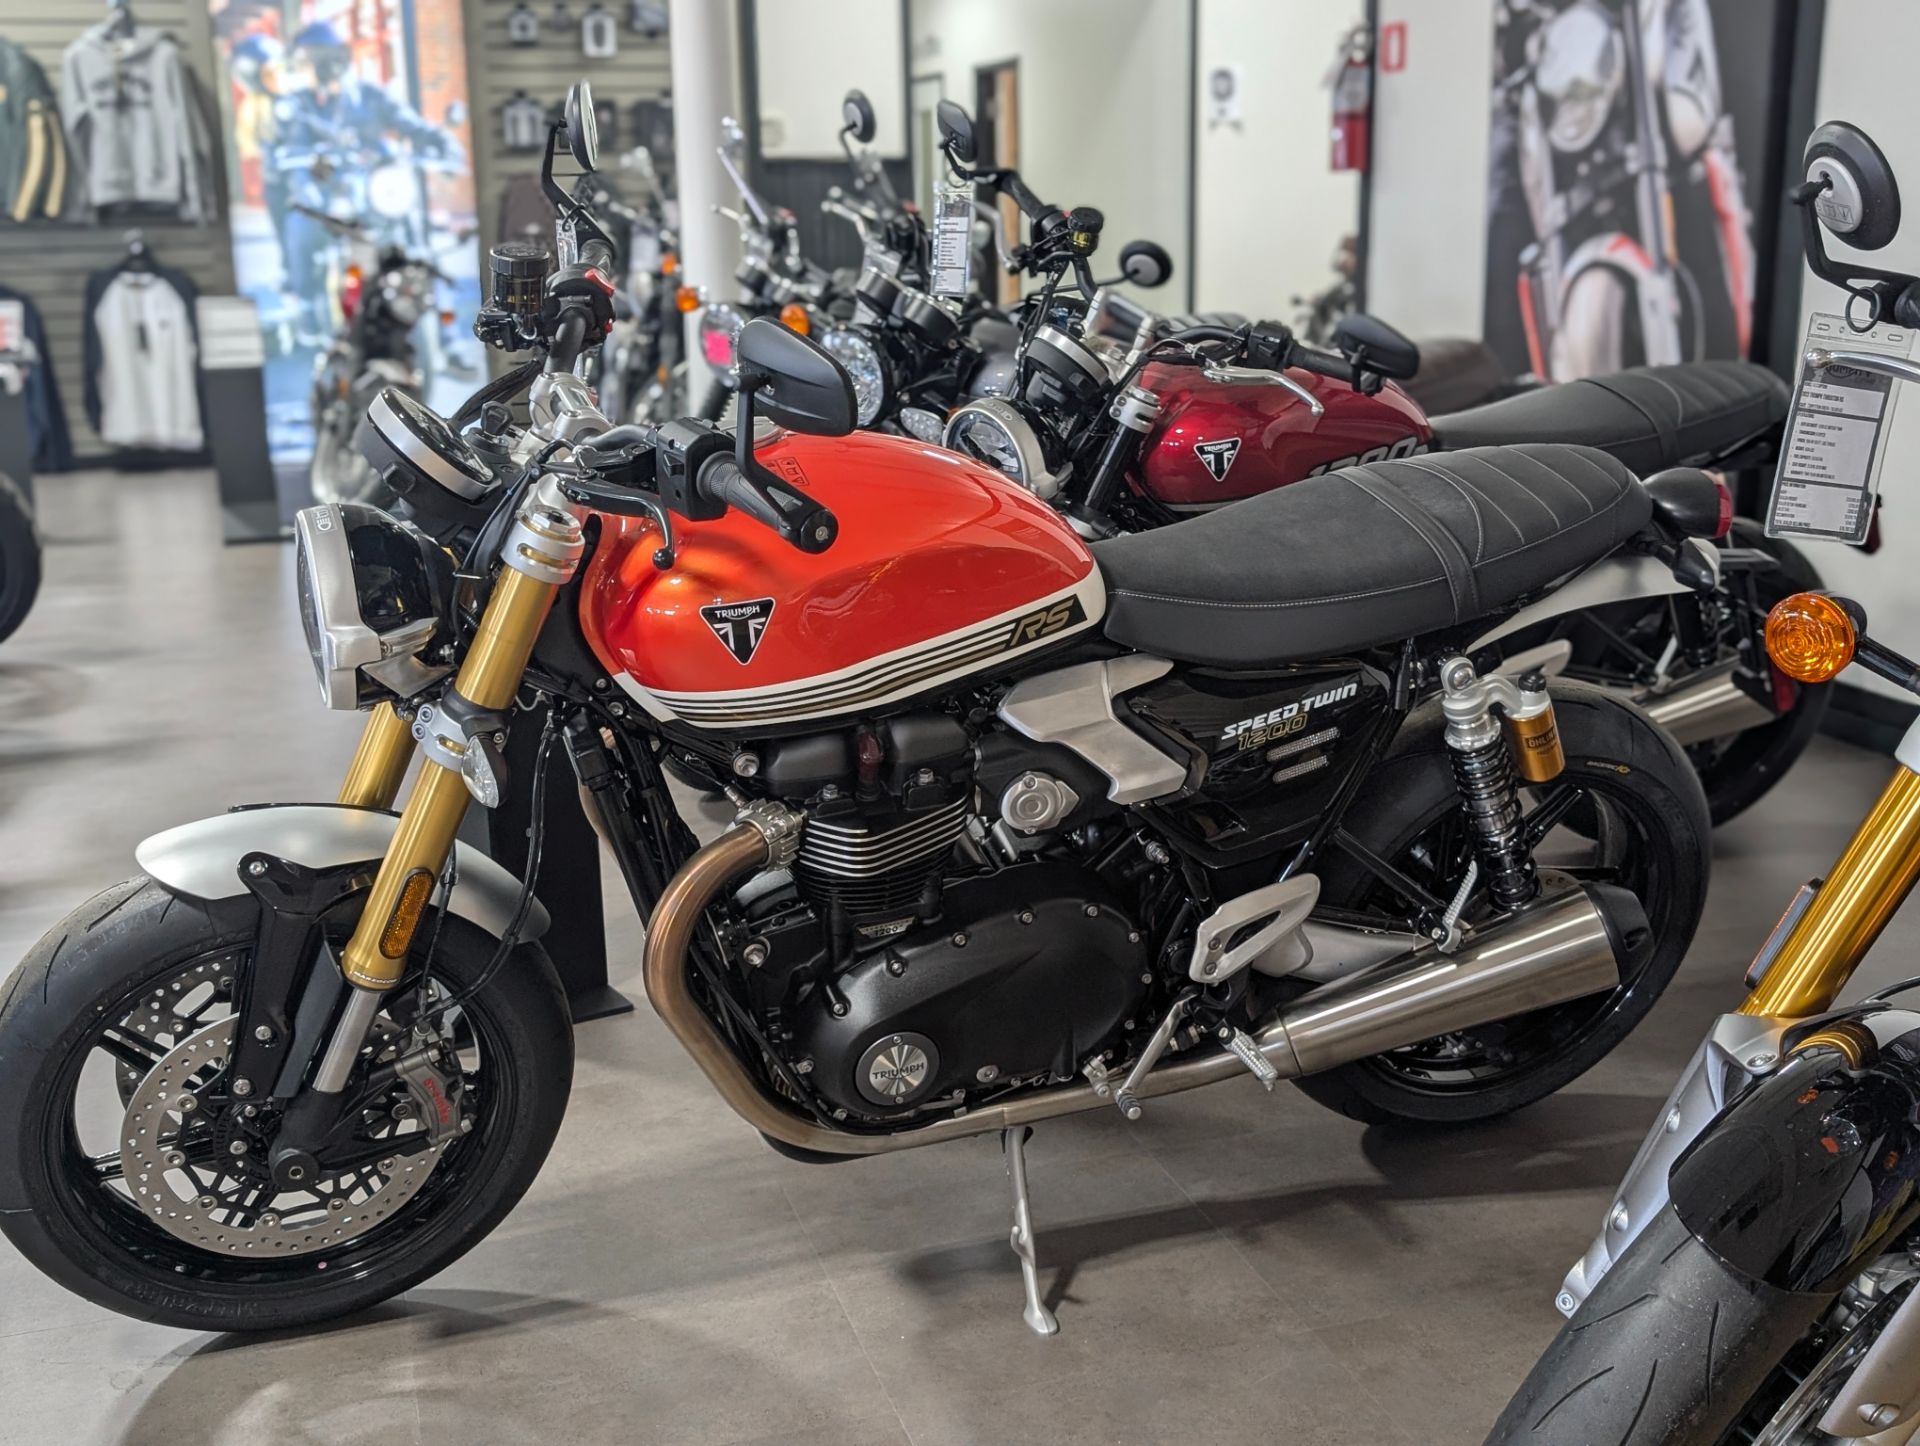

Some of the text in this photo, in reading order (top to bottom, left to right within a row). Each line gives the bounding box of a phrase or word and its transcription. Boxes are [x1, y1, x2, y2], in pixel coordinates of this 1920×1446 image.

[715, 605, 760, 620] TRIUMPH
[1010, 599, 1075, 646] RS
[1221, 683, 1357, 740] SPEED TWIN
[1238, 713, 1307, 750] 1200
[872, 1062, 924, 1080] TRIUMPH
